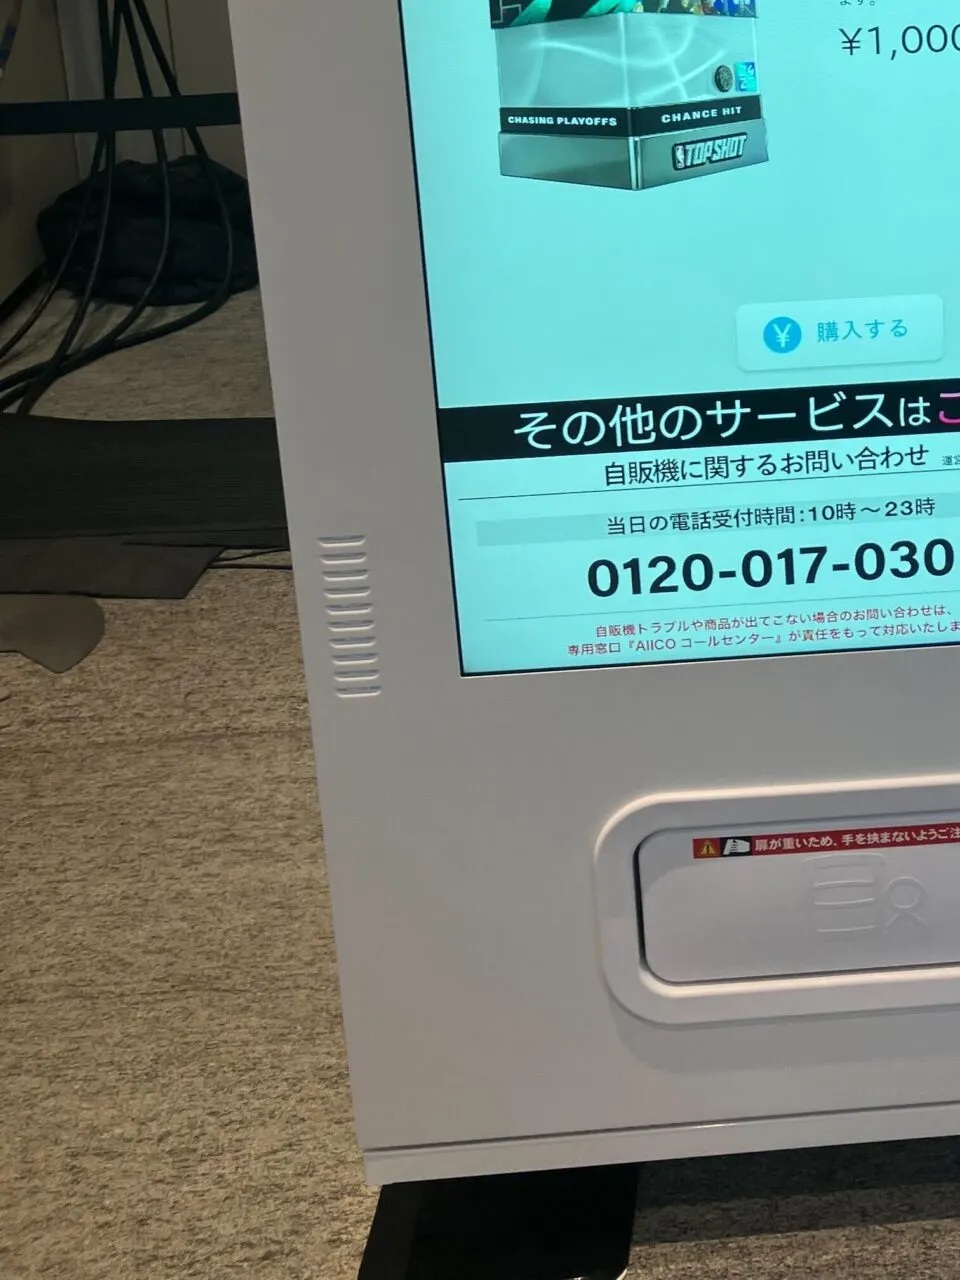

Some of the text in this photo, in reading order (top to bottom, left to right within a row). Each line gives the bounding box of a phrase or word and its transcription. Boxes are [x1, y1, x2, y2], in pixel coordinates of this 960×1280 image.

[507, 116, 617, 126] CHASING PLAYOFFS
[661, 106, 742, 123] CHANCE HIT
[817, 319, 908, 342] 購入する
[604, 444, 929, 486] 自販機に関するお問い合わせ
[587, 538, 956, 598] 0120-017-030
